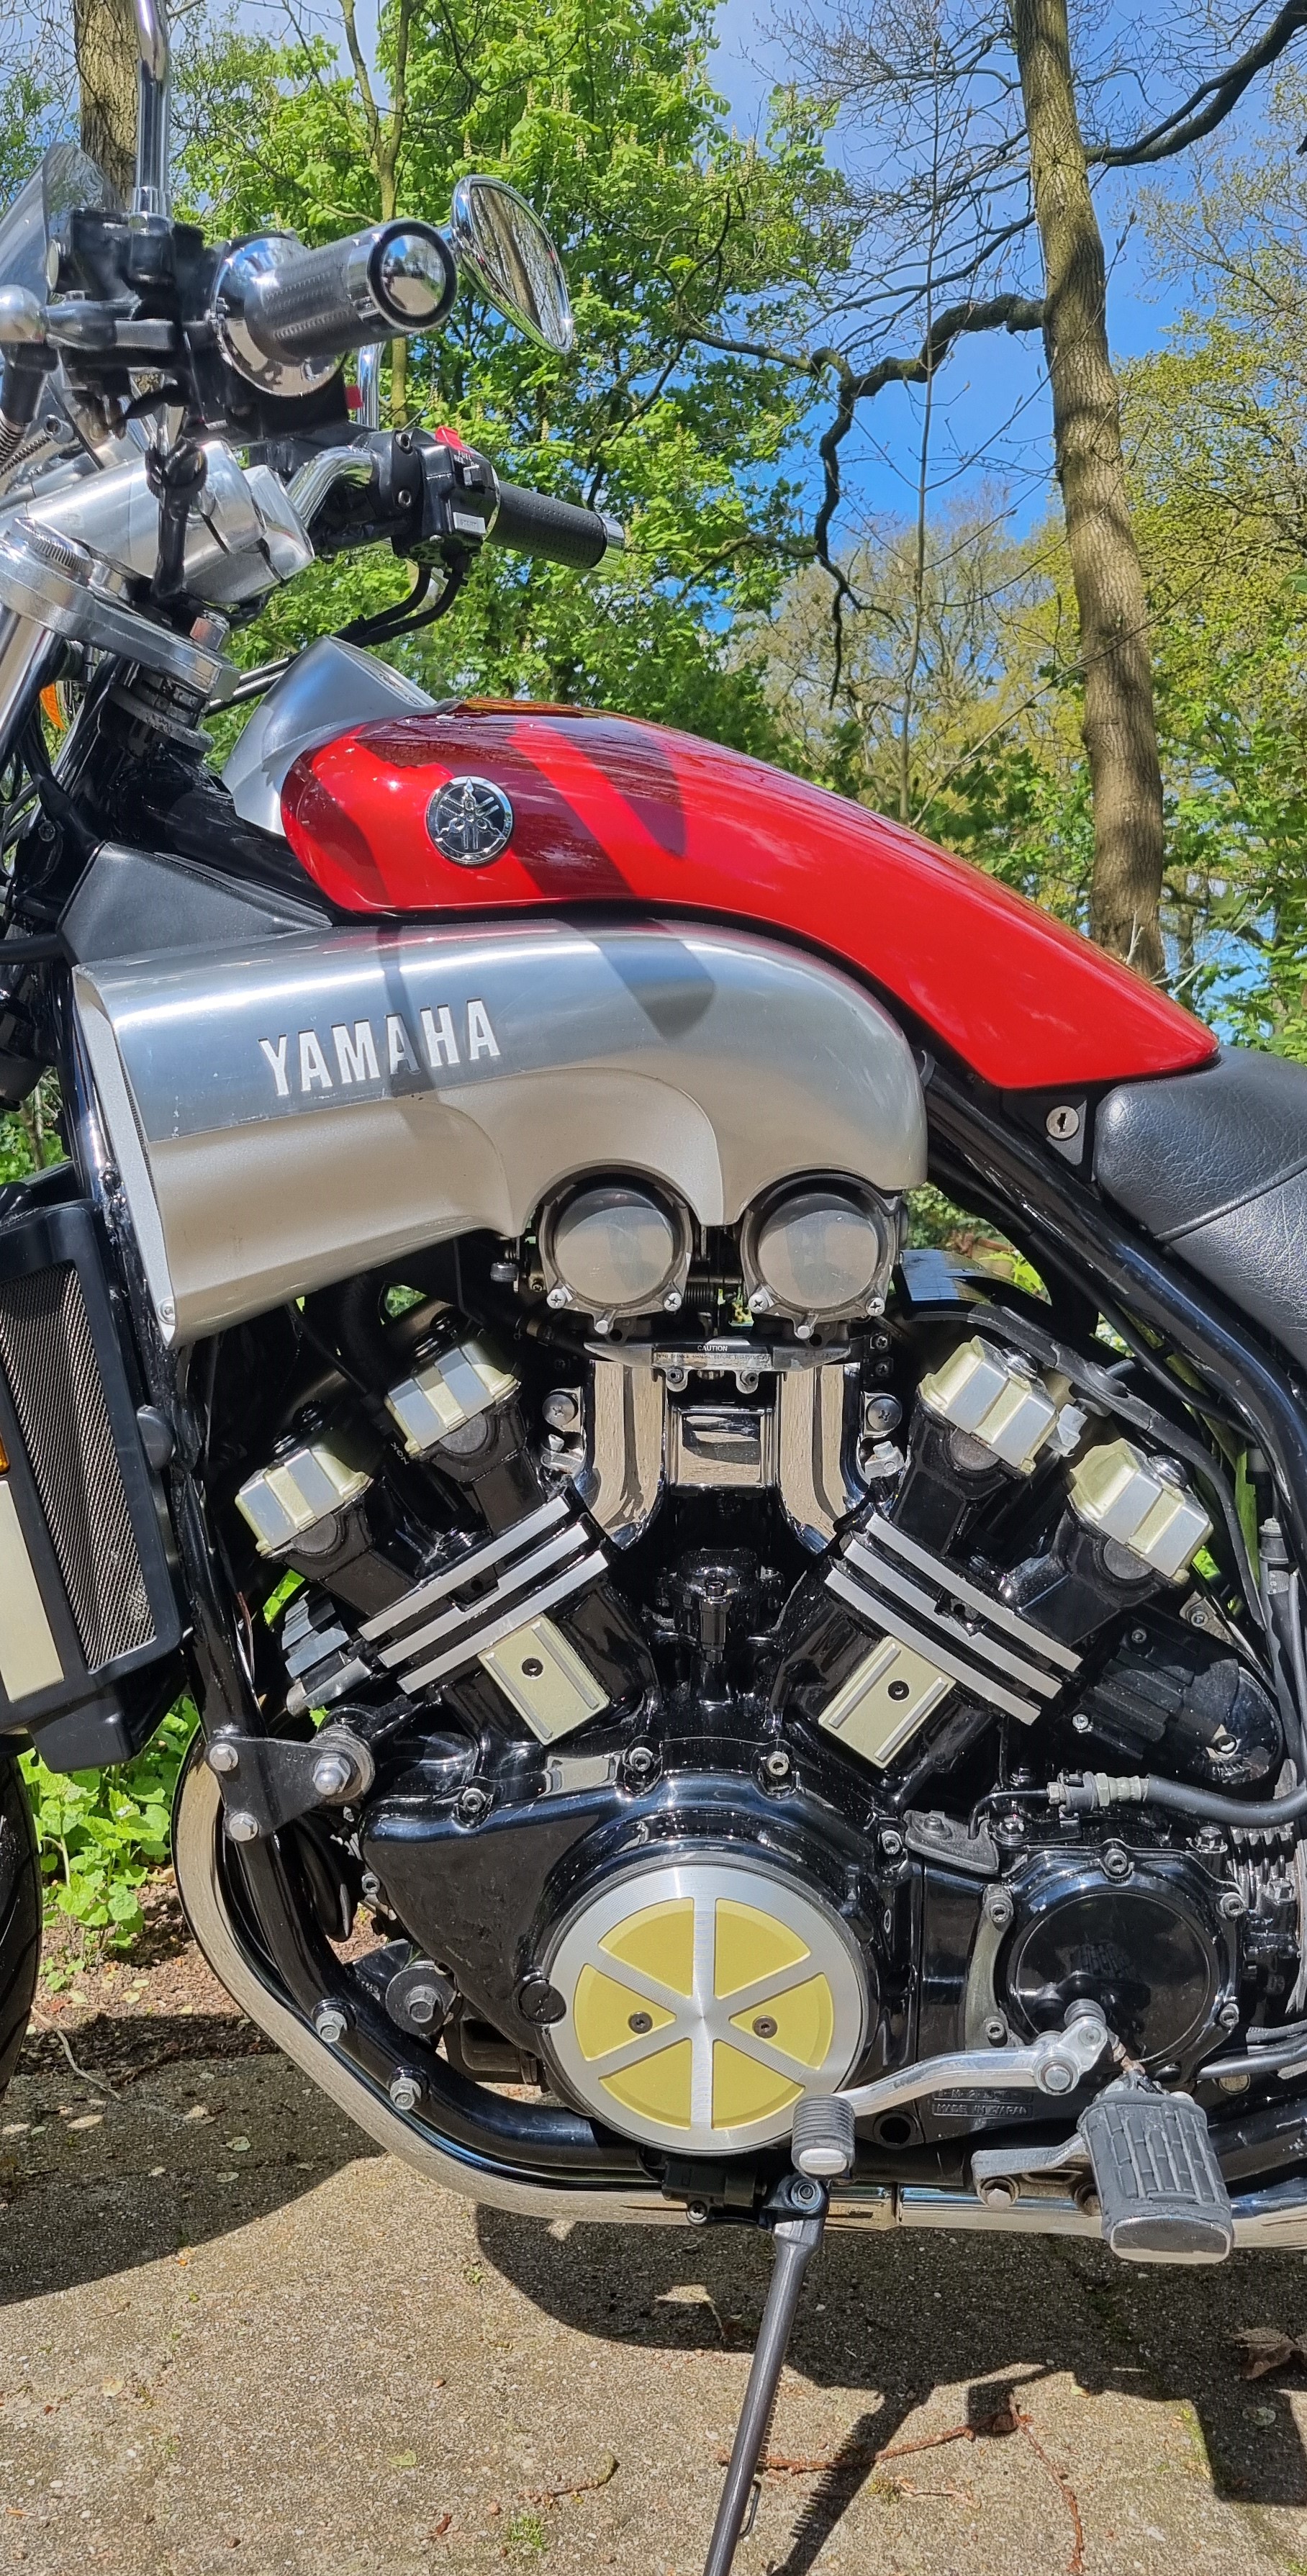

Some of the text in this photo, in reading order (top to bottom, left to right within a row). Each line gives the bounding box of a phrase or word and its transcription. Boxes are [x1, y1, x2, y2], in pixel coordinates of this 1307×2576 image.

[458, 450, 472, 461] FUEL
[258, 998, 501, 1096] YAMAHA
[391, 1442, 410, 1465] NOK
[286, 1752, 306, 1763] OUT
[937, 2103, 1027, 2115] MADE IN JAPAN
